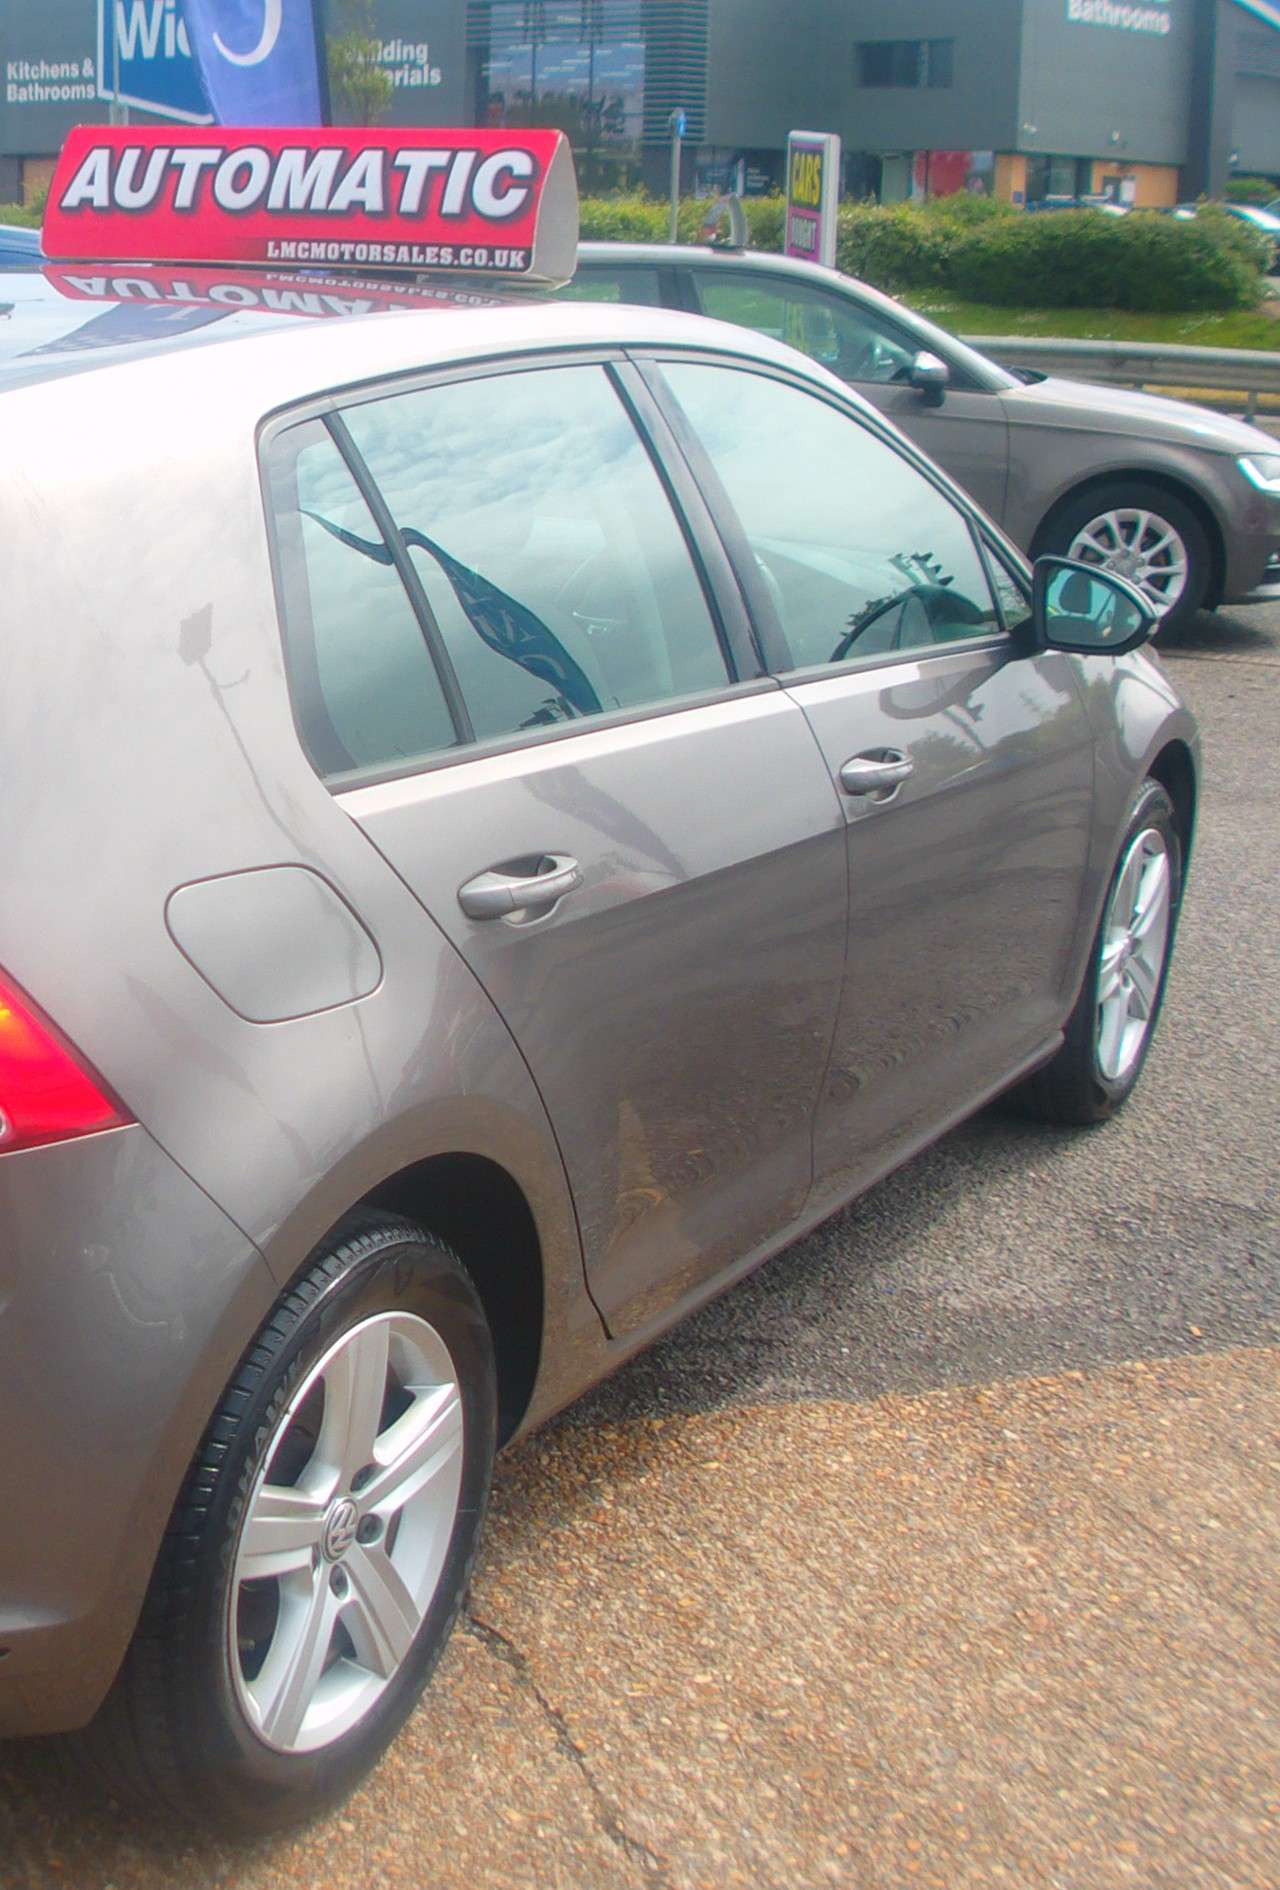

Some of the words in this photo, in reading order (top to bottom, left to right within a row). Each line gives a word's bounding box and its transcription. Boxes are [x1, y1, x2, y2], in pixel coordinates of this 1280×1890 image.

[7, 59, 80, 80] Kitchens
[82, 57, 95, 77] &
[7, 82, 96, 102] Bathrooms
[61, 147, 534, 218] AUTOMATIC
[267, 240, 526, 269] LMCMOTORSALES.CO.UK
